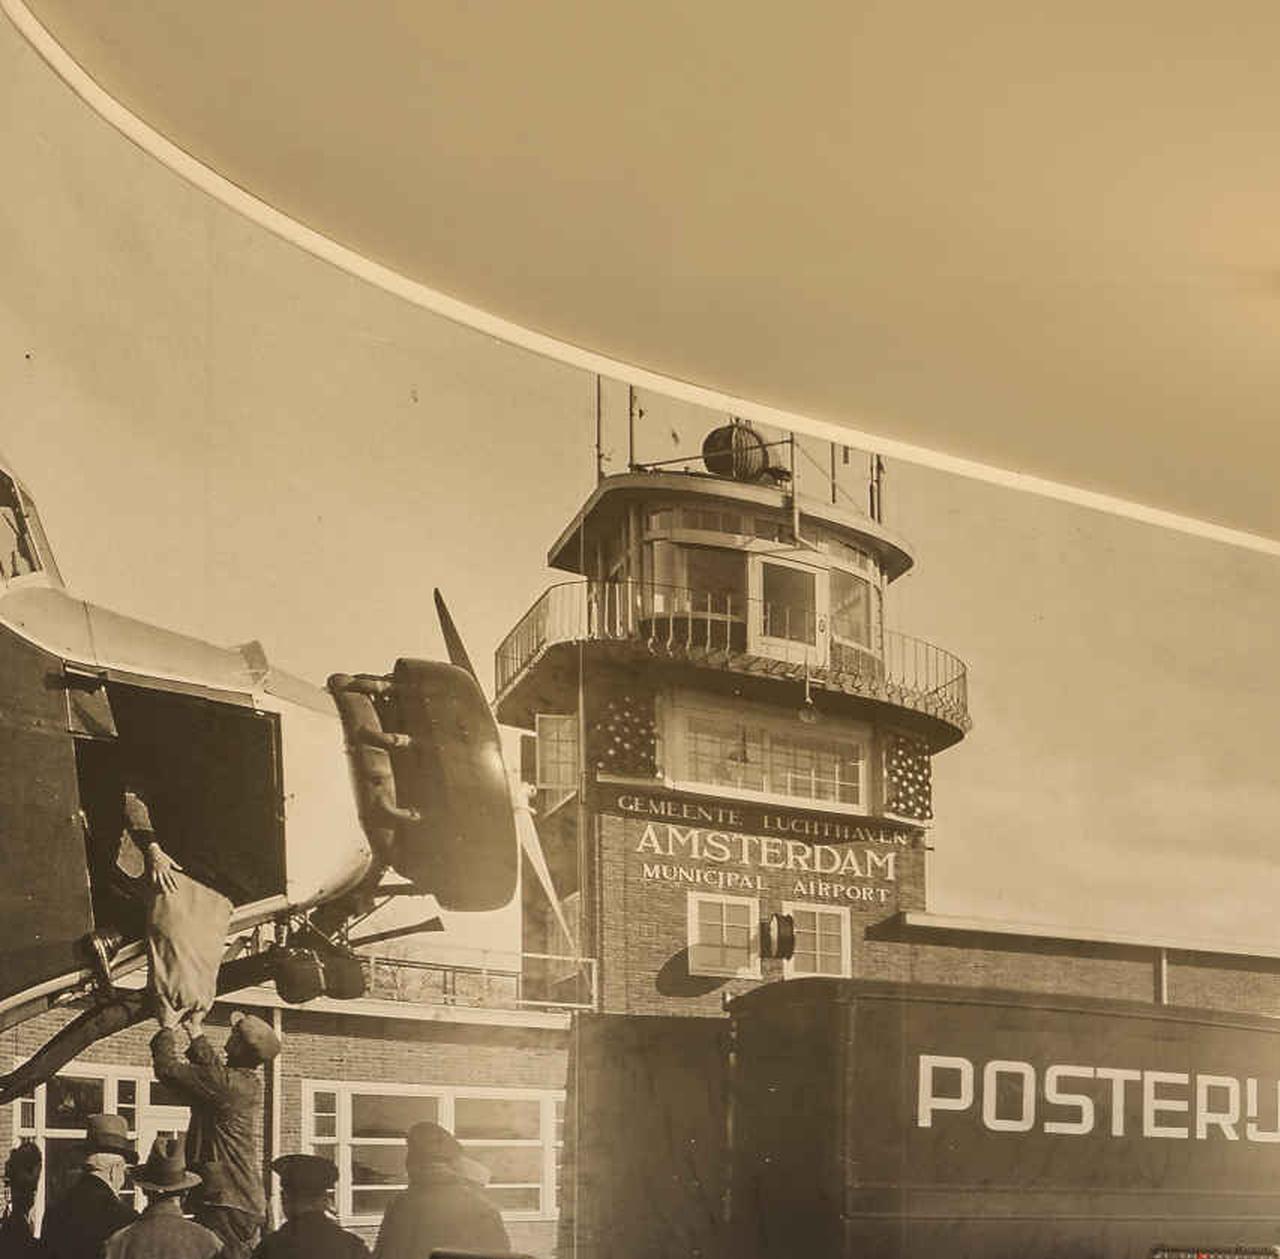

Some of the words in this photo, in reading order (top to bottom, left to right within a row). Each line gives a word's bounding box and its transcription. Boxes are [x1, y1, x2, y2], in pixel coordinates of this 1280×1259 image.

[617, 795, 740, 825] GEMEENTE
[763, 814, 908, 846] LUCHTHAVEN
[636, 824, 897, 881] AMSTERDAM
[642, 863, 770, 890] MUNICIPAL
[792, 880, 891, 903] AIRPORT
